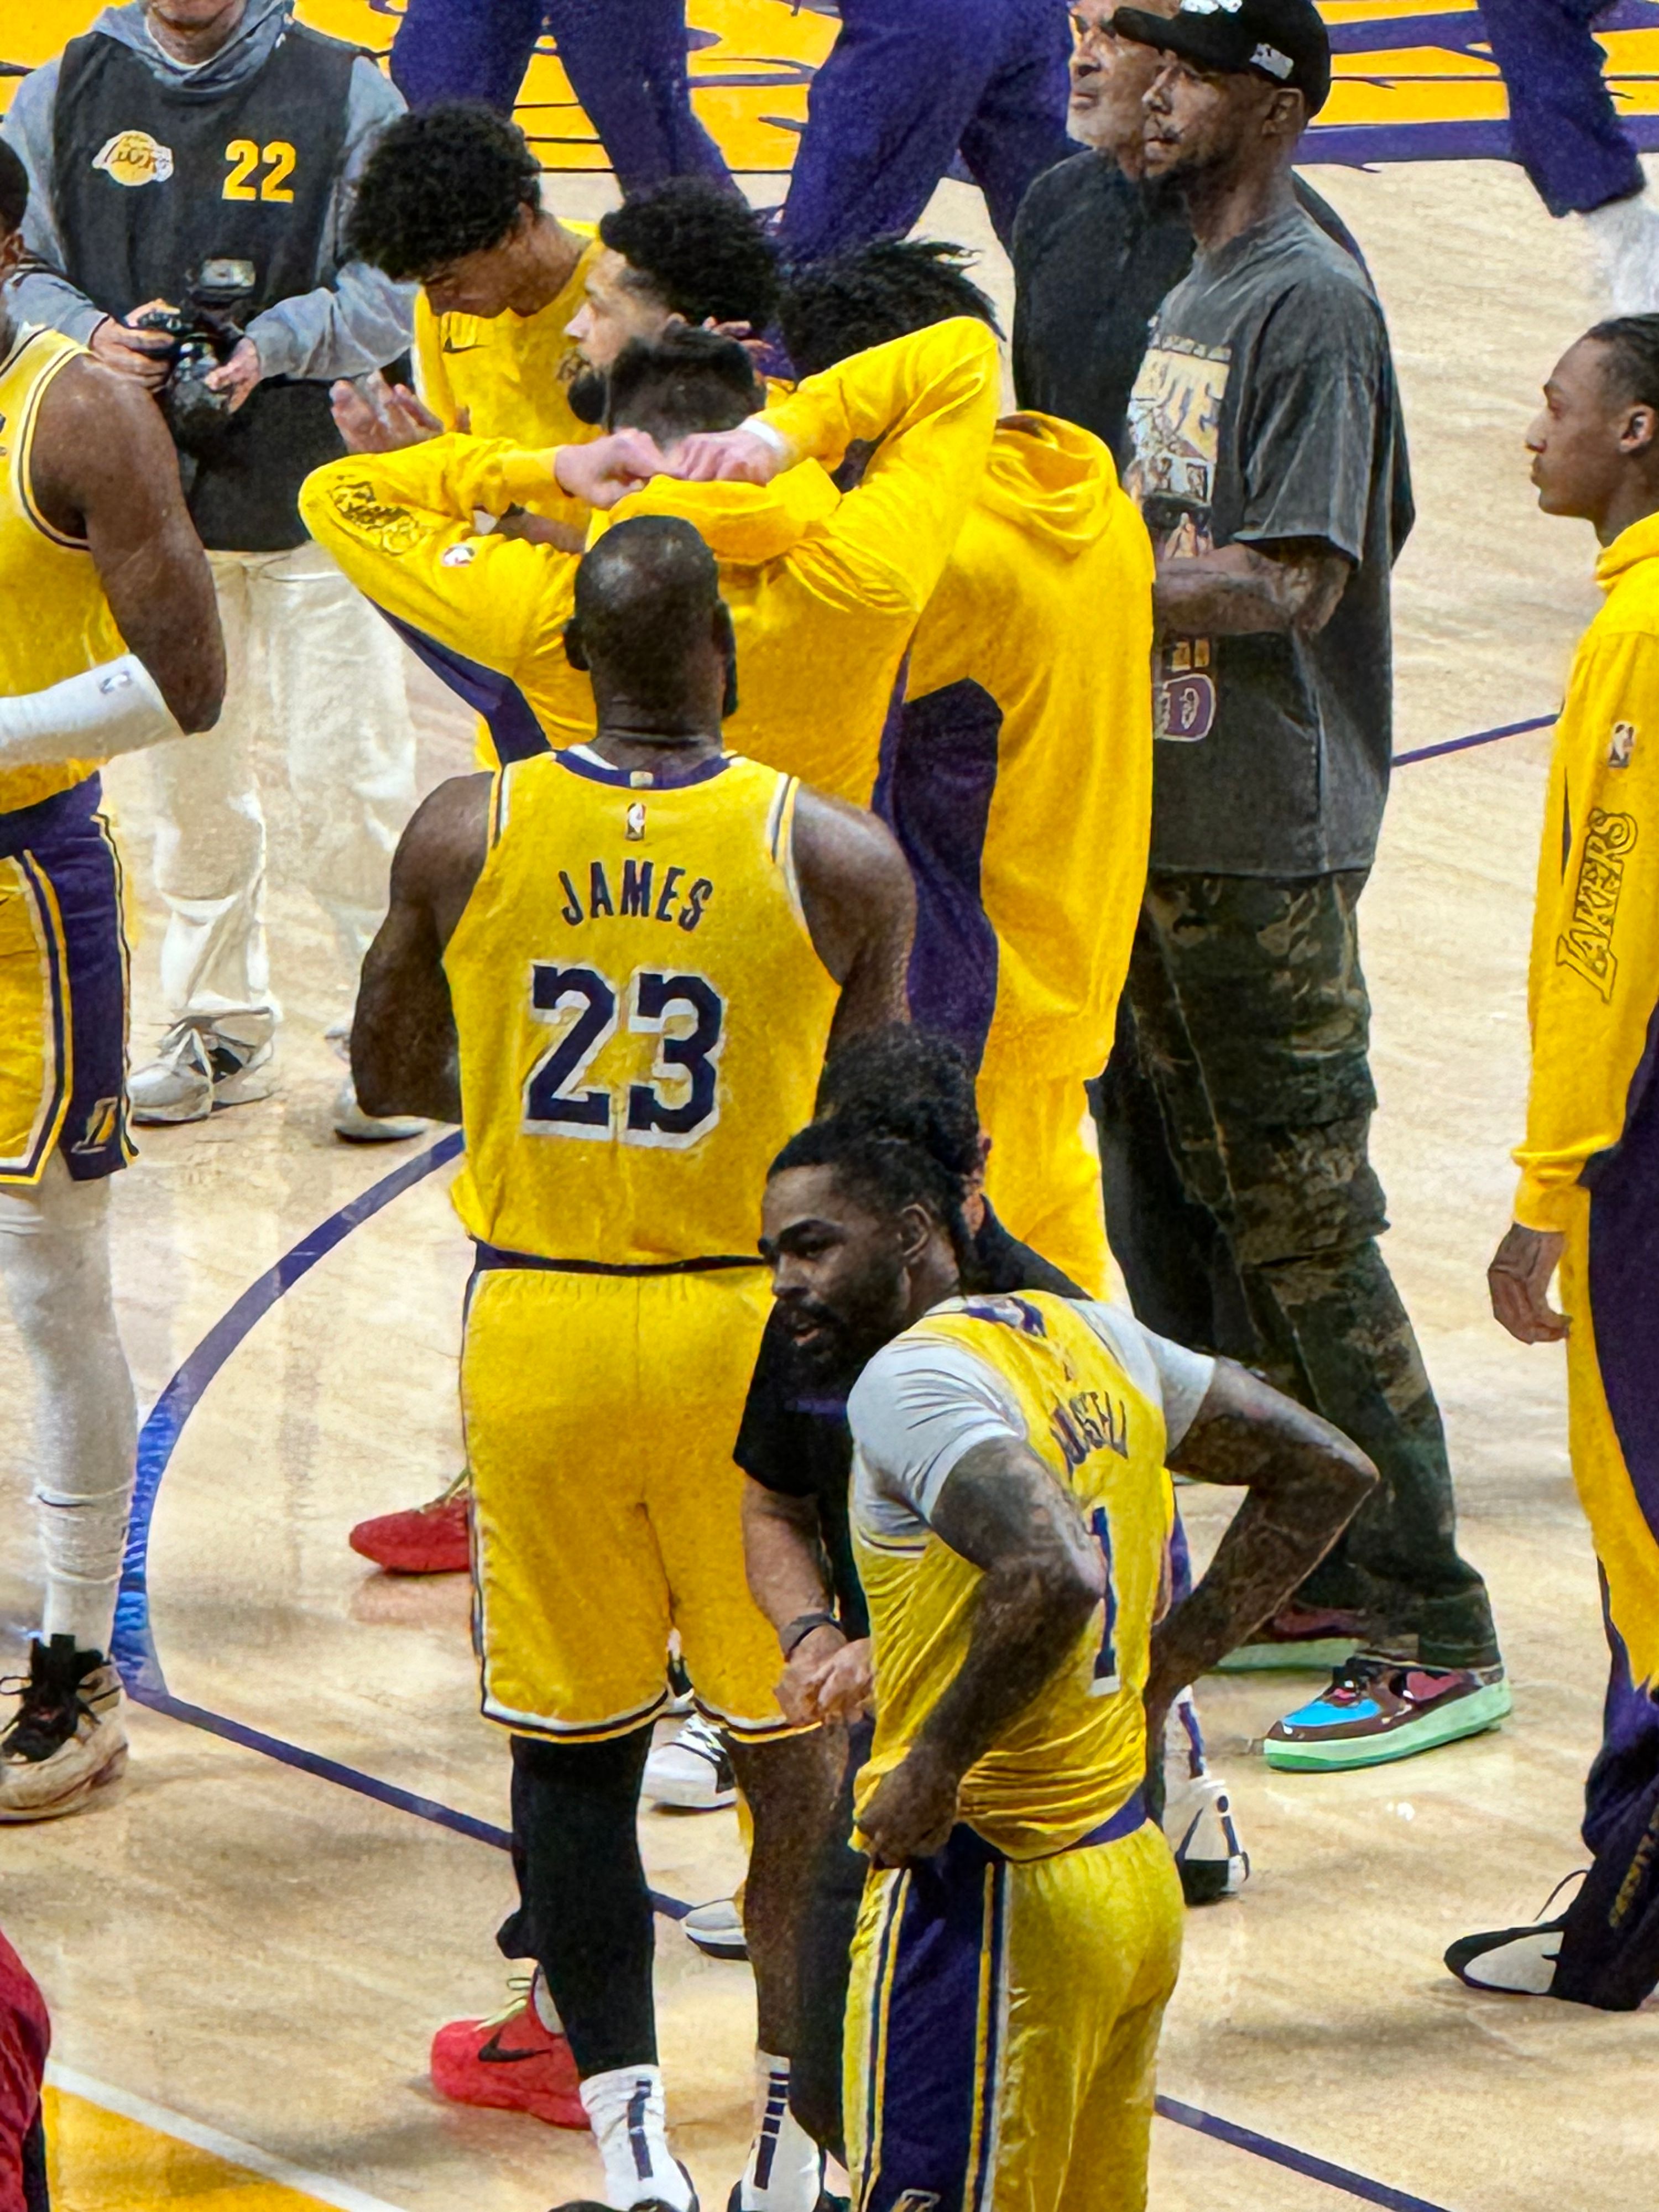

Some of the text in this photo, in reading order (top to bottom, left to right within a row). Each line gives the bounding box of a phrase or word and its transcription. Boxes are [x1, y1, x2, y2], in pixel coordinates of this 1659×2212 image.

[222, 139, 296, 204] 22
[558, 859, 713, 932] JAMES
[523, 960, 726, 1149] 23
